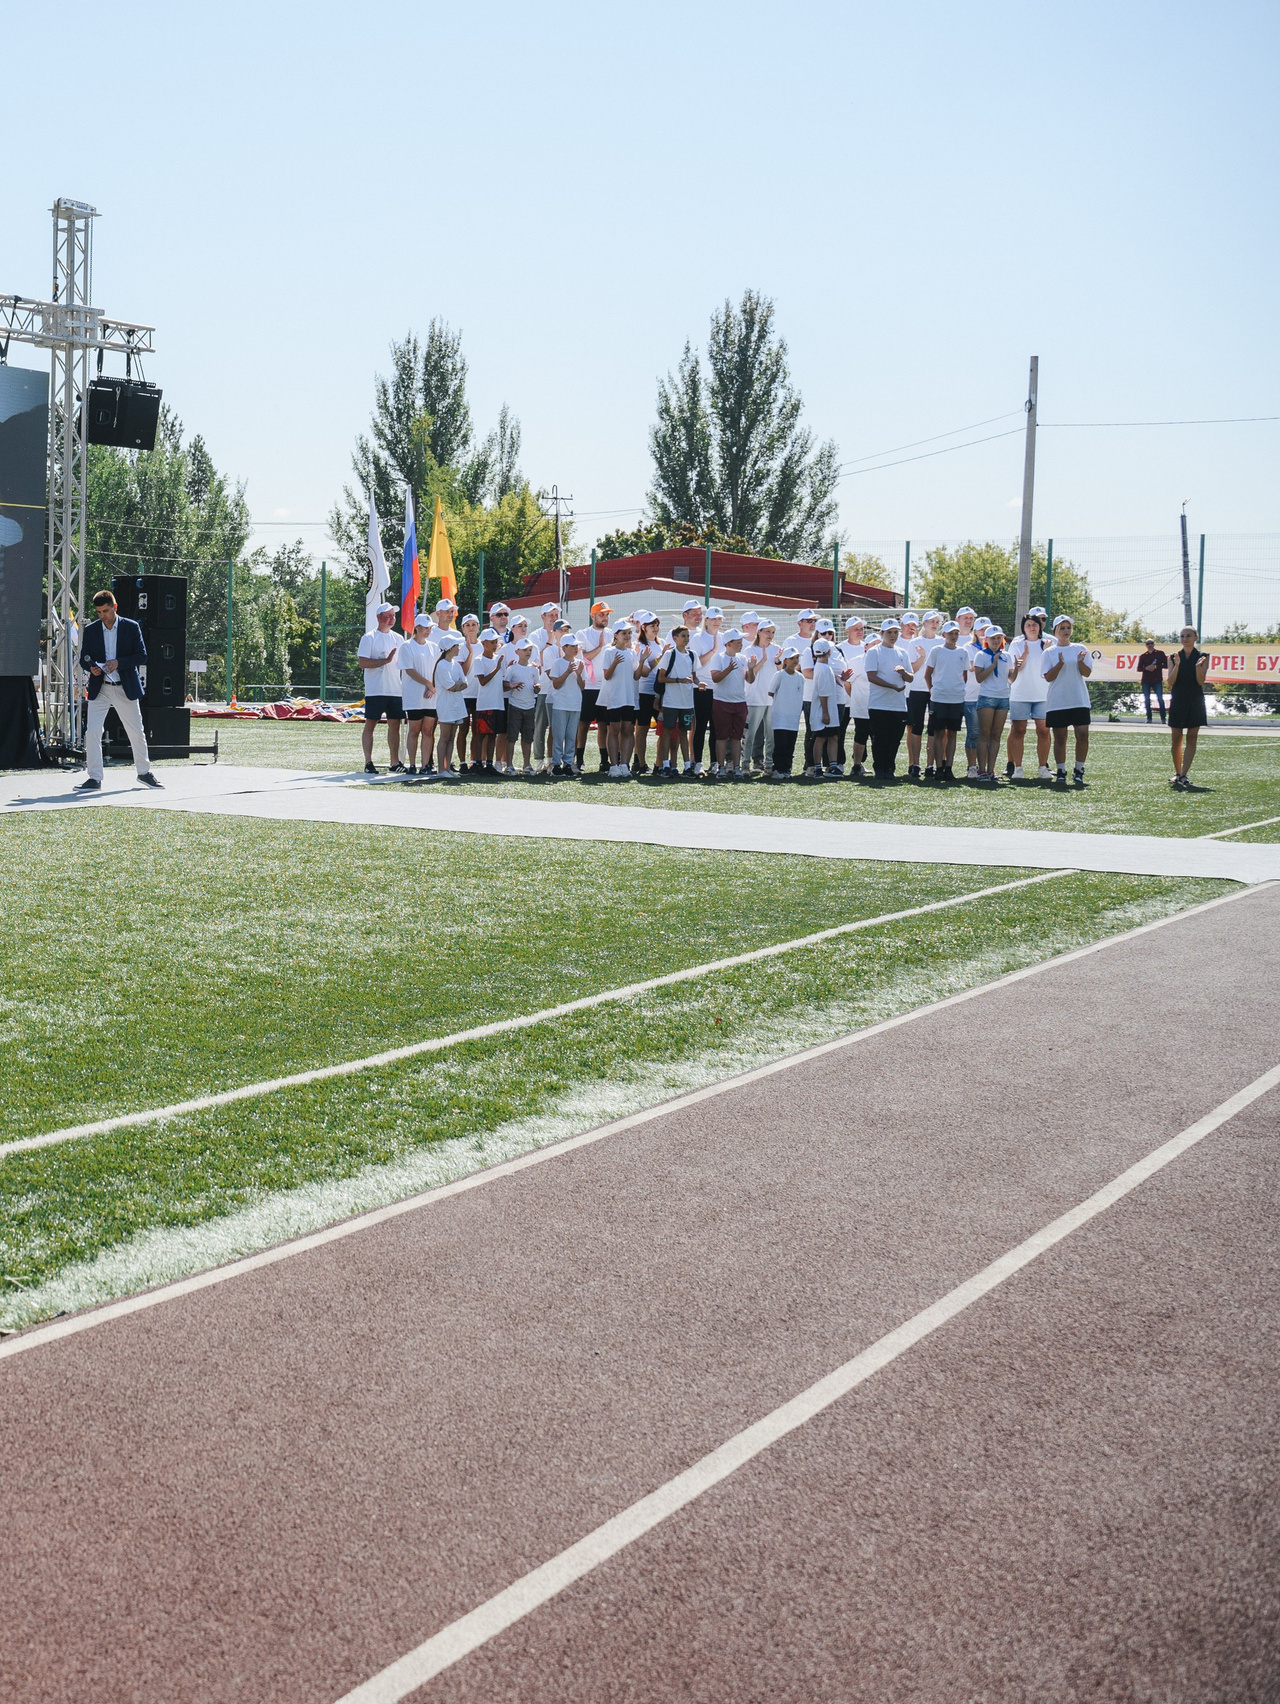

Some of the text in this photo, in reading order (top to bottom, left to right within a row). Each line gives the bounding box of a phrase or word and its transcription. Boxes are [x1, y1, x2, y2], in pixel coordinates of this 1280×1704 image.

[1116, 655, 1280, 674] БУ РТЕ! БУ
